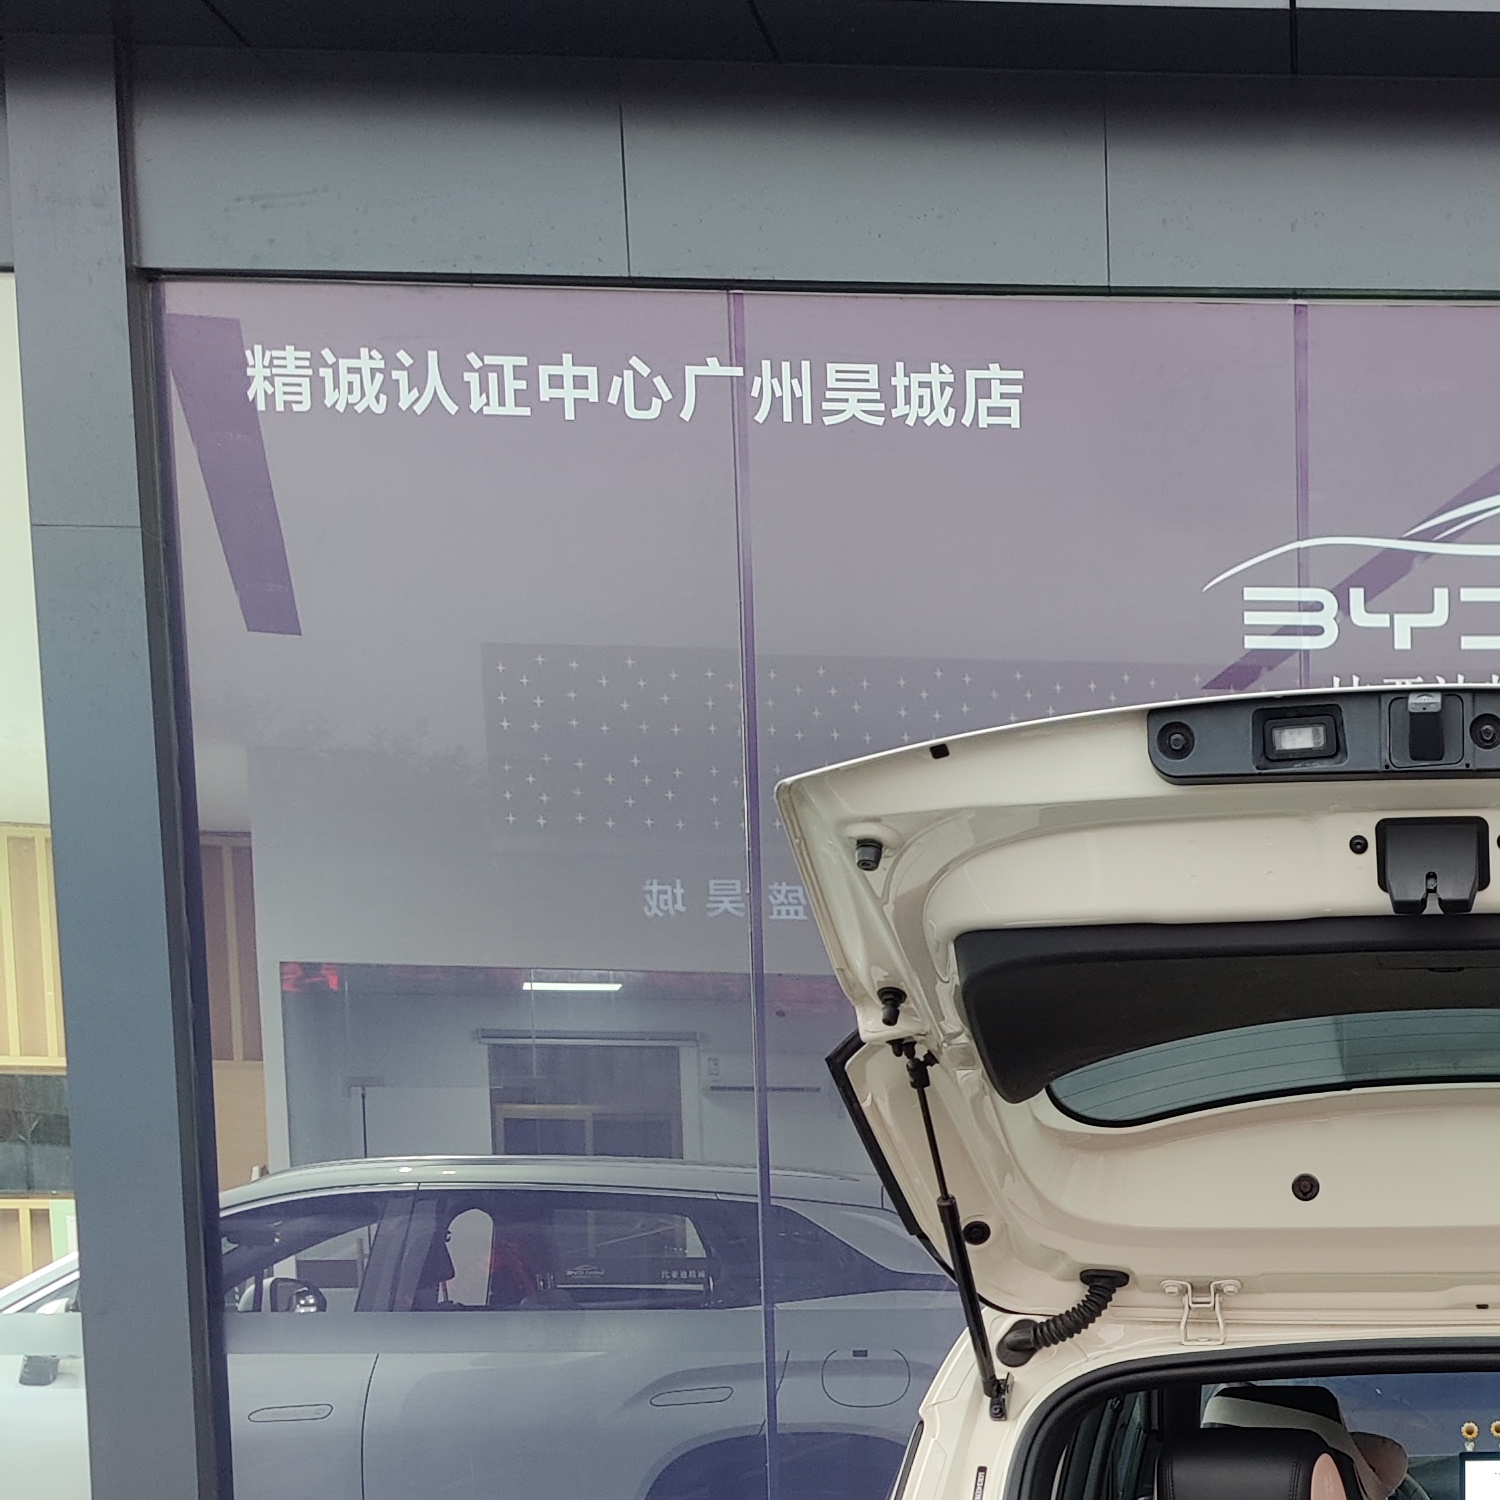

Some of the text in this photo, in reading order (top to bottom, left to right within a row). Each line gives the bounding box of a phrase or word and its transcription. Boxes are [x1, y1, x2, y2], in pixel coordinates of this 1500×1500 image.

[245, 344, 1026, 429] 精诚认证中心广州昊城店
